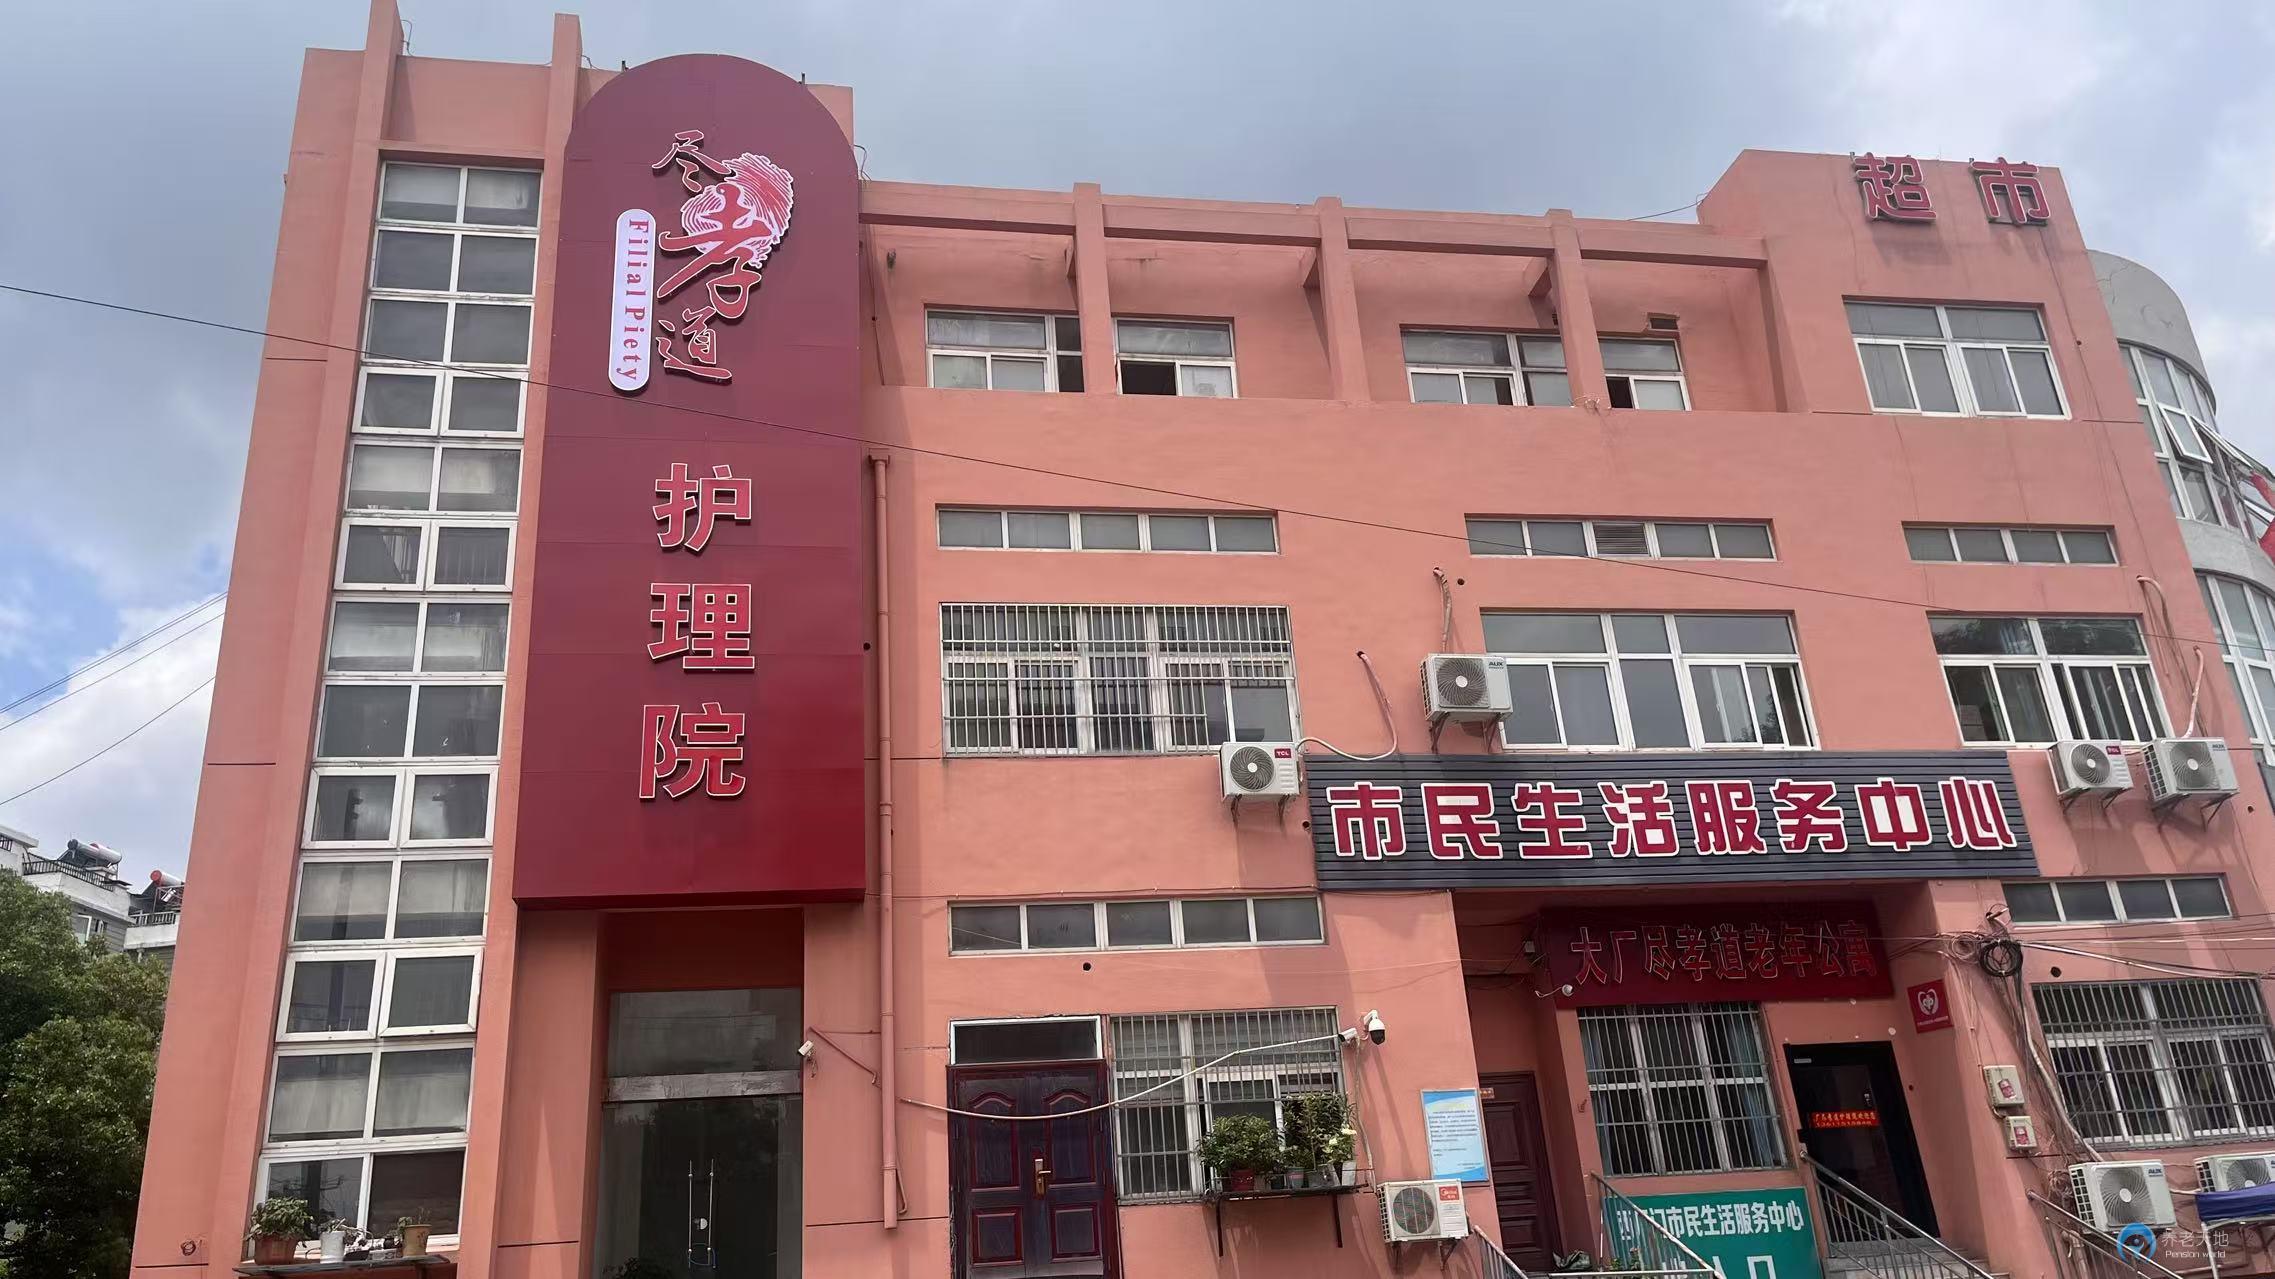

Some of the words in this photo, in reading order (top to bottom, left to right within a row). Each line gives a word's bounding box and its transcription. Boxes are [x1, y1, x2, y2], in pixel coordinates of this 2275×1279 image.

[1854, 152, 2051, 224] 超市
[625, 219, 650, 297] Filial
[616, 305, 646, 381] Piety
[640, 462, 755, 798] 护理院
[1325, 777, 2014, 860] 市民生活服务中心
[1570, 920, 1878, 985] 大厂尽孝道老年公寓
